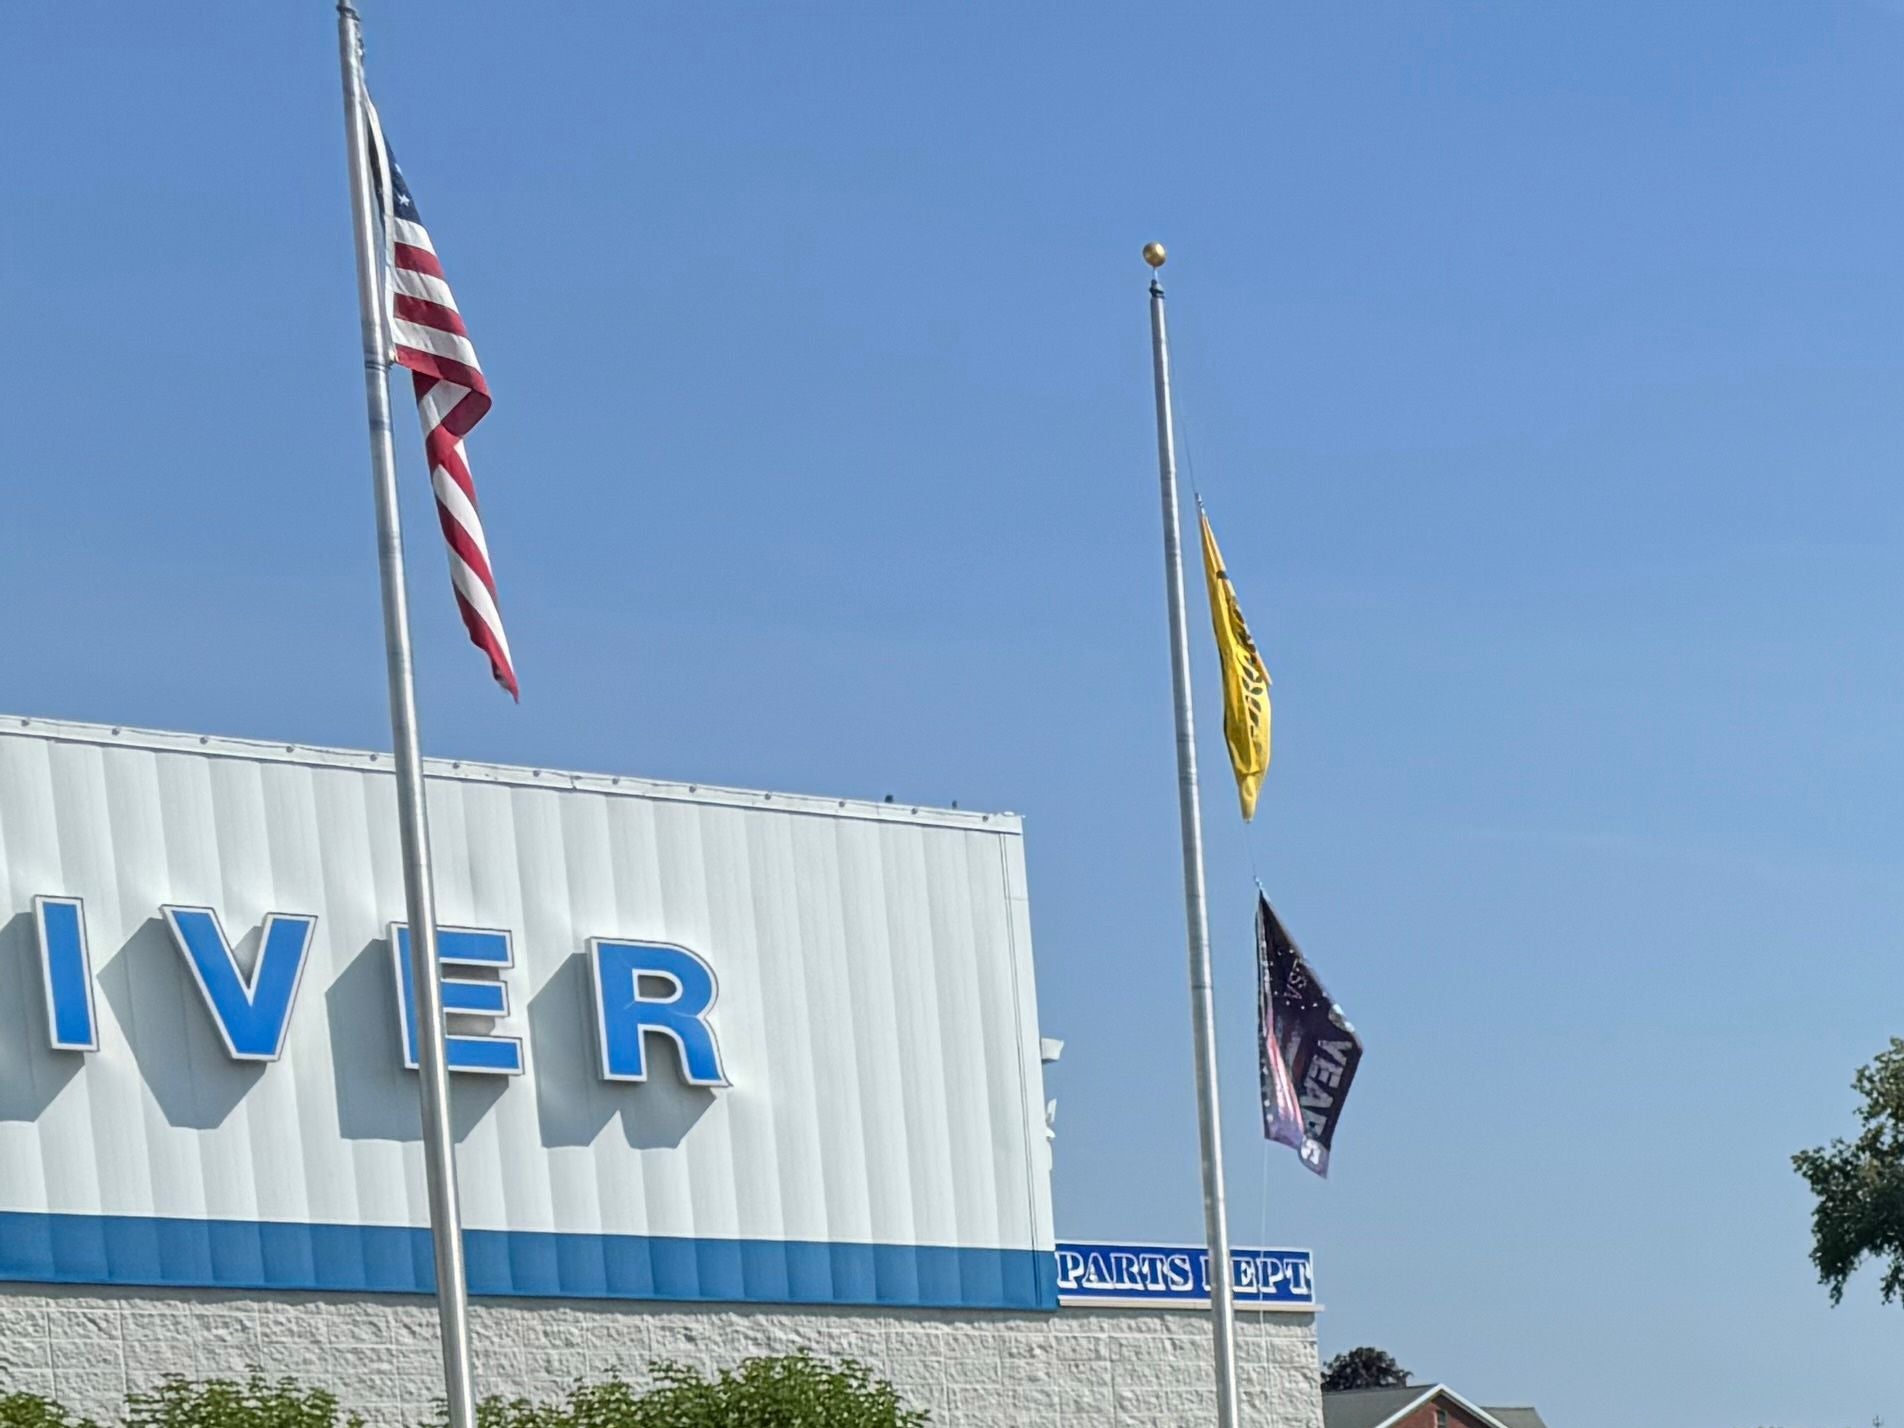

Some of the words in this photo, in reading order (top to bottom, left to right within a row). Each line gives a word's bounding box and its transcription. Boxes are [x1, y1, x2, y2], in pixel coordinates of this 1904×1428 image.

[30, 894, 734, 1088] IVER
[1055, 1251, 1194, 1292] PARTS
[1200, 1255, 1312, 1295] EPT
